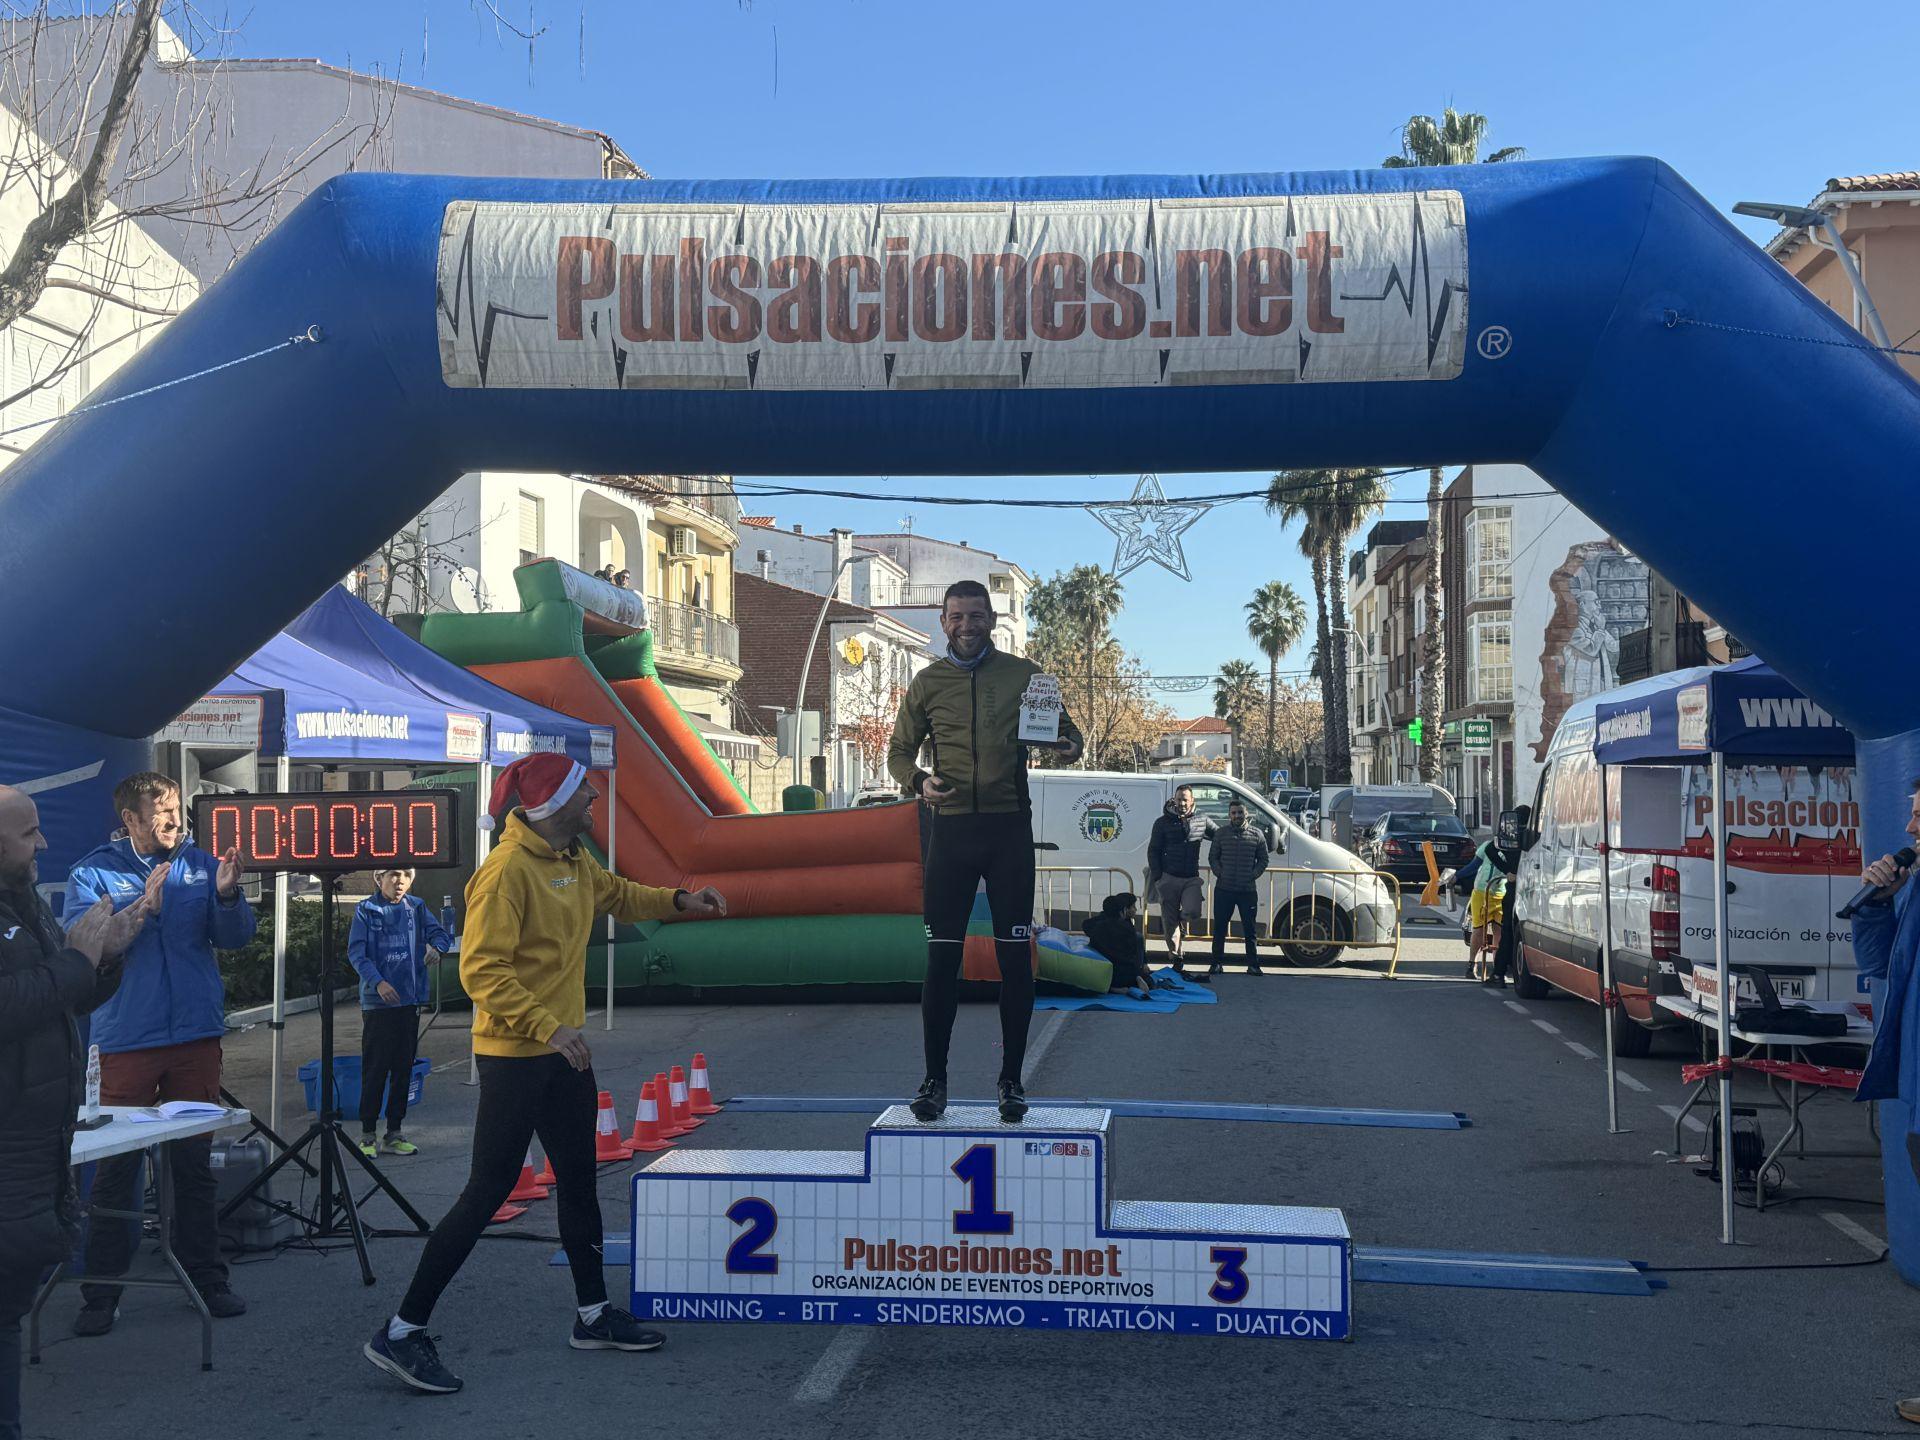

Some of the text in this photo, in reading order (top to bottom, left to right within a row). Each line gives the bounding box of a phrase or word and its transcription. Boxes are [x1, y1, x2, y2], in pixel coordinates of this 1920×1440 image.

[556, 230, 1345, 344] Pulsaciones.net
[296, 708, 409, 740] www.pulsaciones.net
[1465, 736, 1490, 744] ESTEBAN
[1468, 724, 1489, 733] ÓPTICA
[1684, 926, 1791, 942] orgnización
[1800, 929, 1821, 942] de
[950, 1143, 1014, 1236] 1
[725, 1196, 779, 1275] 2
[844, 1237, 1123, 1277] Pulsaciones.net
[1208, 1246, 1250, 1304] 3
[812, 1274, 1154, 1298] ORGANIZACIÓN DE EVENTOS DEPORTIVOS
[652, 1298, 763, 1320] RUNNING
[802, 1301, 839, 1321] BTT
[877, 1302, 1025, 1326] SENDERISMO
[1064, 1305, 1175, 1332] TRIATLÓN
[1216, 1312, 1331, 1337] DUATLÓN
